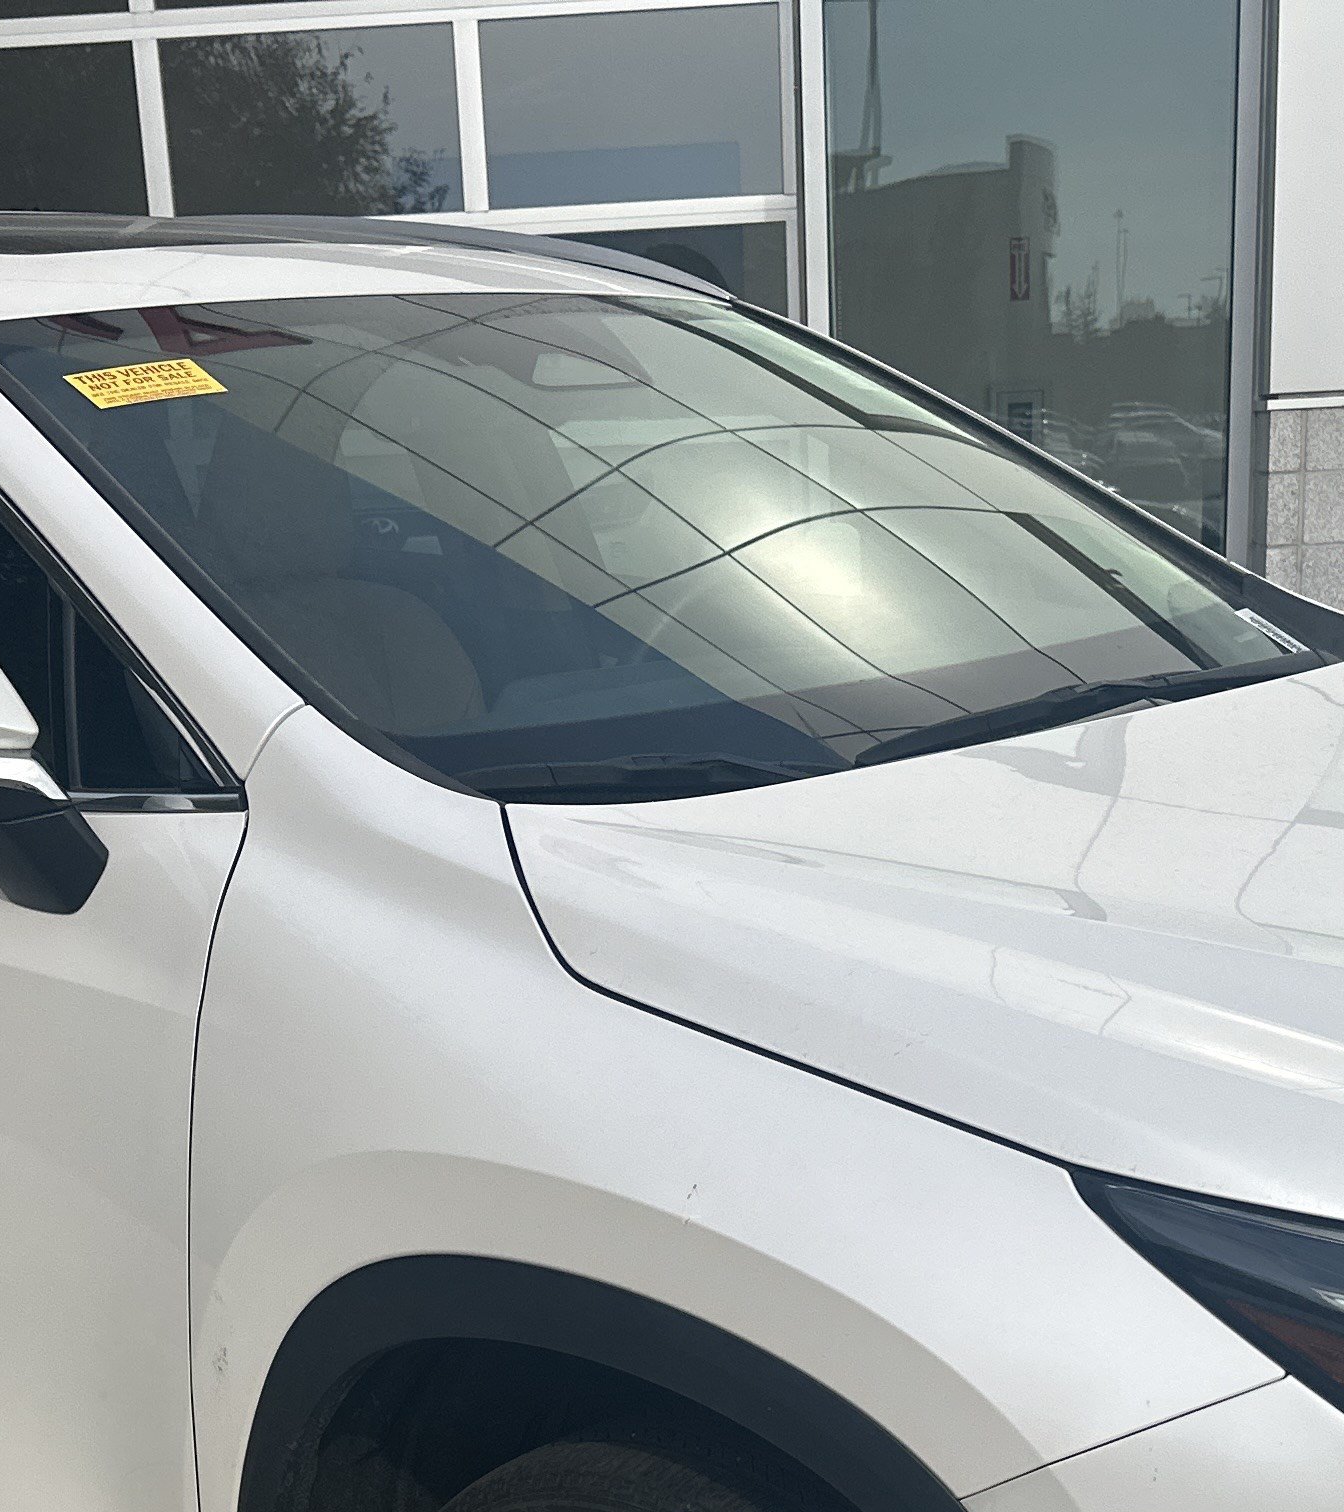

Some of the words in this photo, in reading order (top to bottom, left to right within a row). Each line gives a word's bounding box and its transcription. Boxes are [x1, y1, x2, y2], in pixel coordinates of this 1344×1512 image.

[73, 371, 117, 385] THIS
[115, 362, 192, 377] VEHICLE
[88, 381, 119, 391] NOT
[123, 376, 156, 386] FOR
[157, 371, 196, 381] SALE
